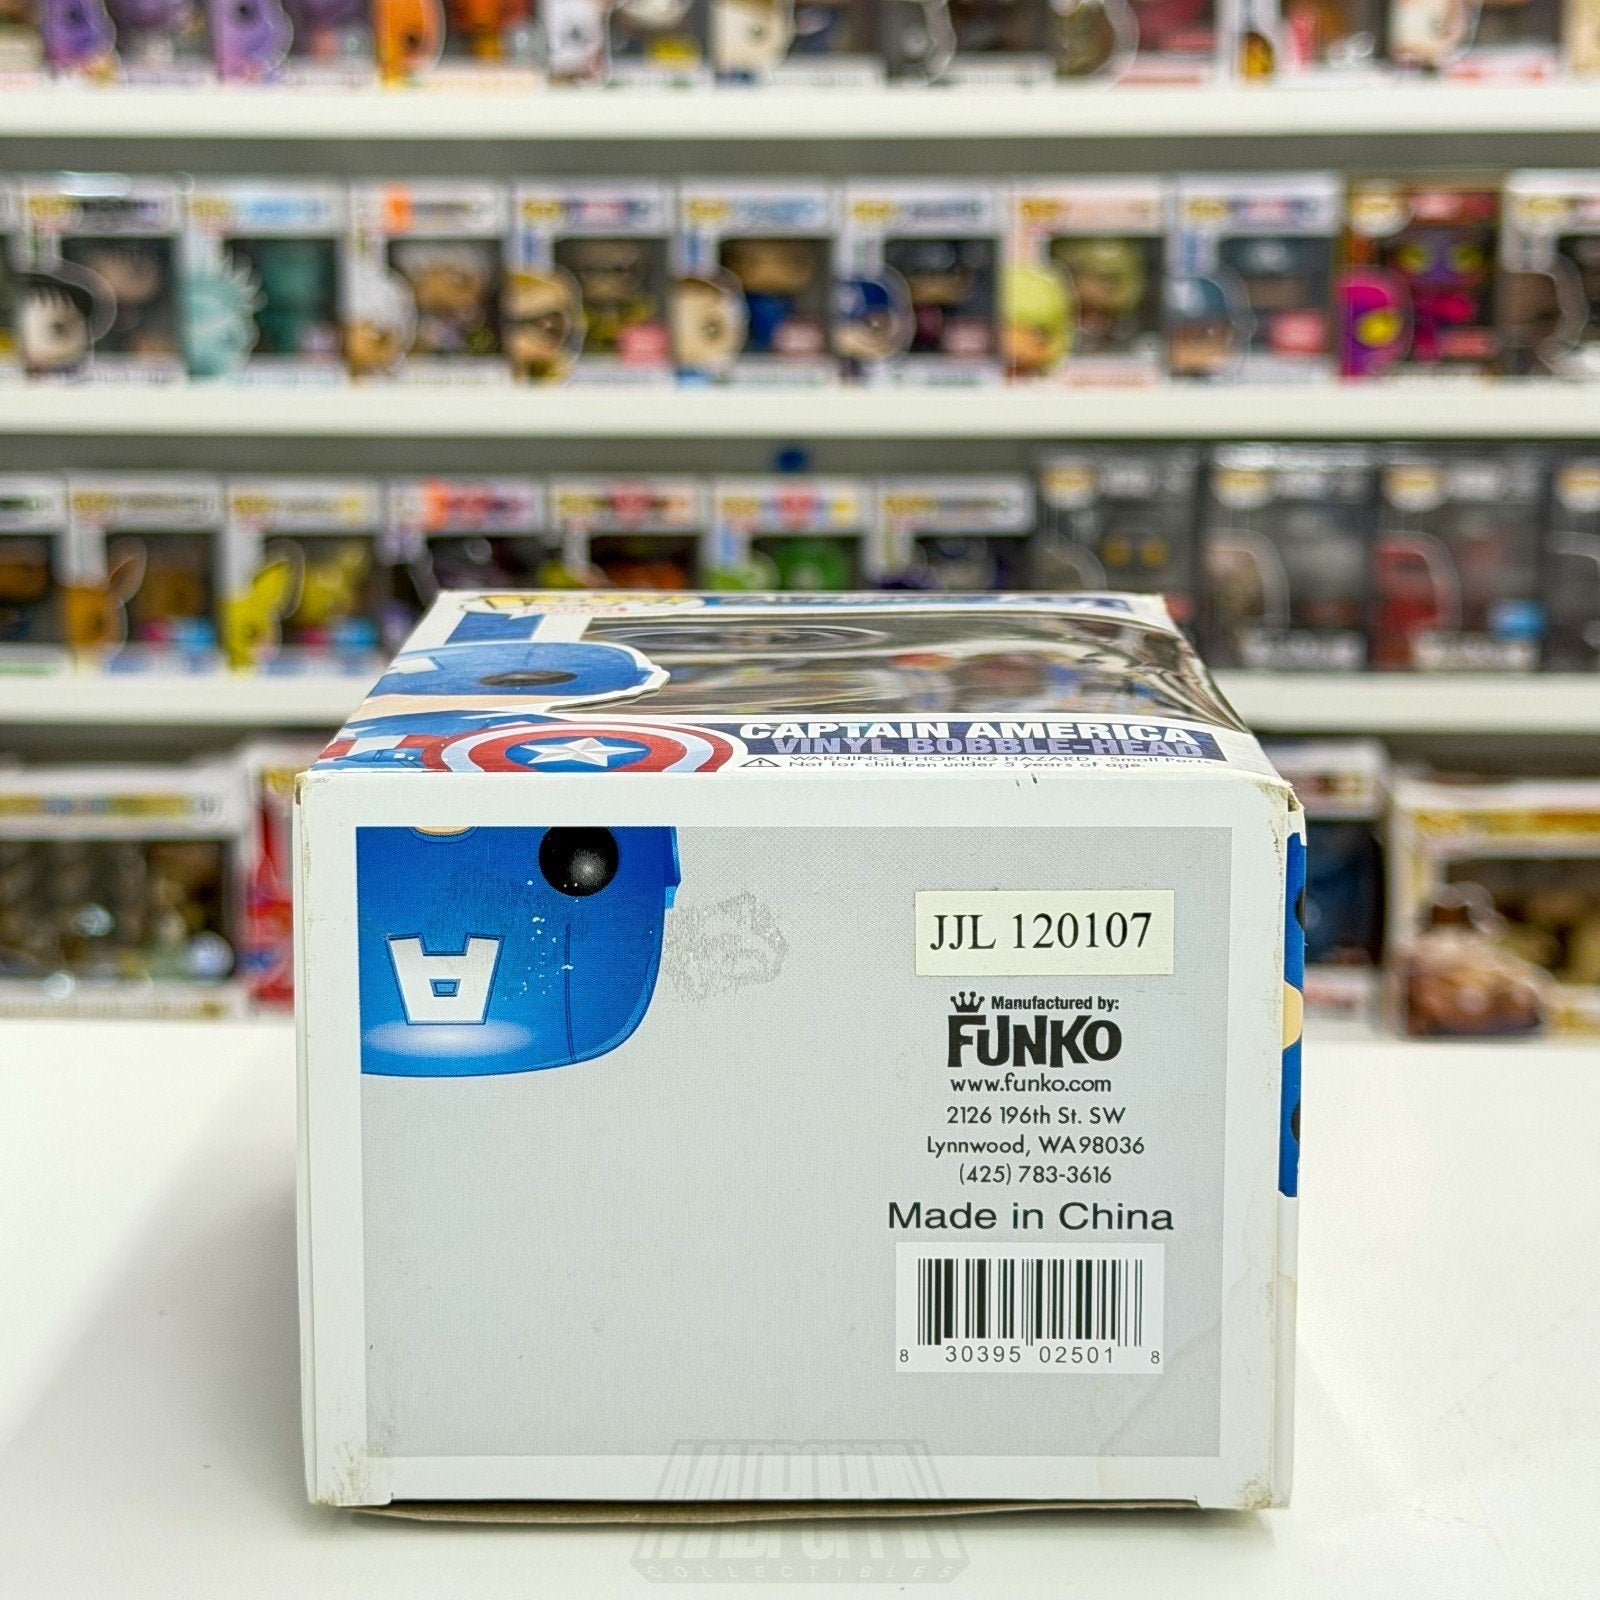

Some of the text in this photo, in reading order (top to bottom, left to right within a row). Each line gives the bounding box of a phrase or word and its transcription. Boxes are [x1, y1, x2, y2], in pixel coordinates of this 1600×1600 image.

[739, 722, 1200, 746] CAPTAIN AMERICA
[773, 737, 1203, 757] VINYL BOBBLE-HEAD
[831, 760, 857, 768] for
[865, 760, 937, 769] children
[930, 912, 1153, 950] JJL 120107
[991, 995, 1119, 1011] Manufactured by:
[947, 1014, 1122, 1068] FUNKO
[950, 1072, 1112, 1092] www.funko.com
[947, 1105, 1126, 1124] 2126 196th St. SW
[927, 1134, 1031, 1158] Lynnwood,
[959, 1163, 1112, 1185] (425) 783-3616
[889, 1201, 1174, 1231] Made in China
[899, 1345, 1160, 1364] 8 30395 02501 8
